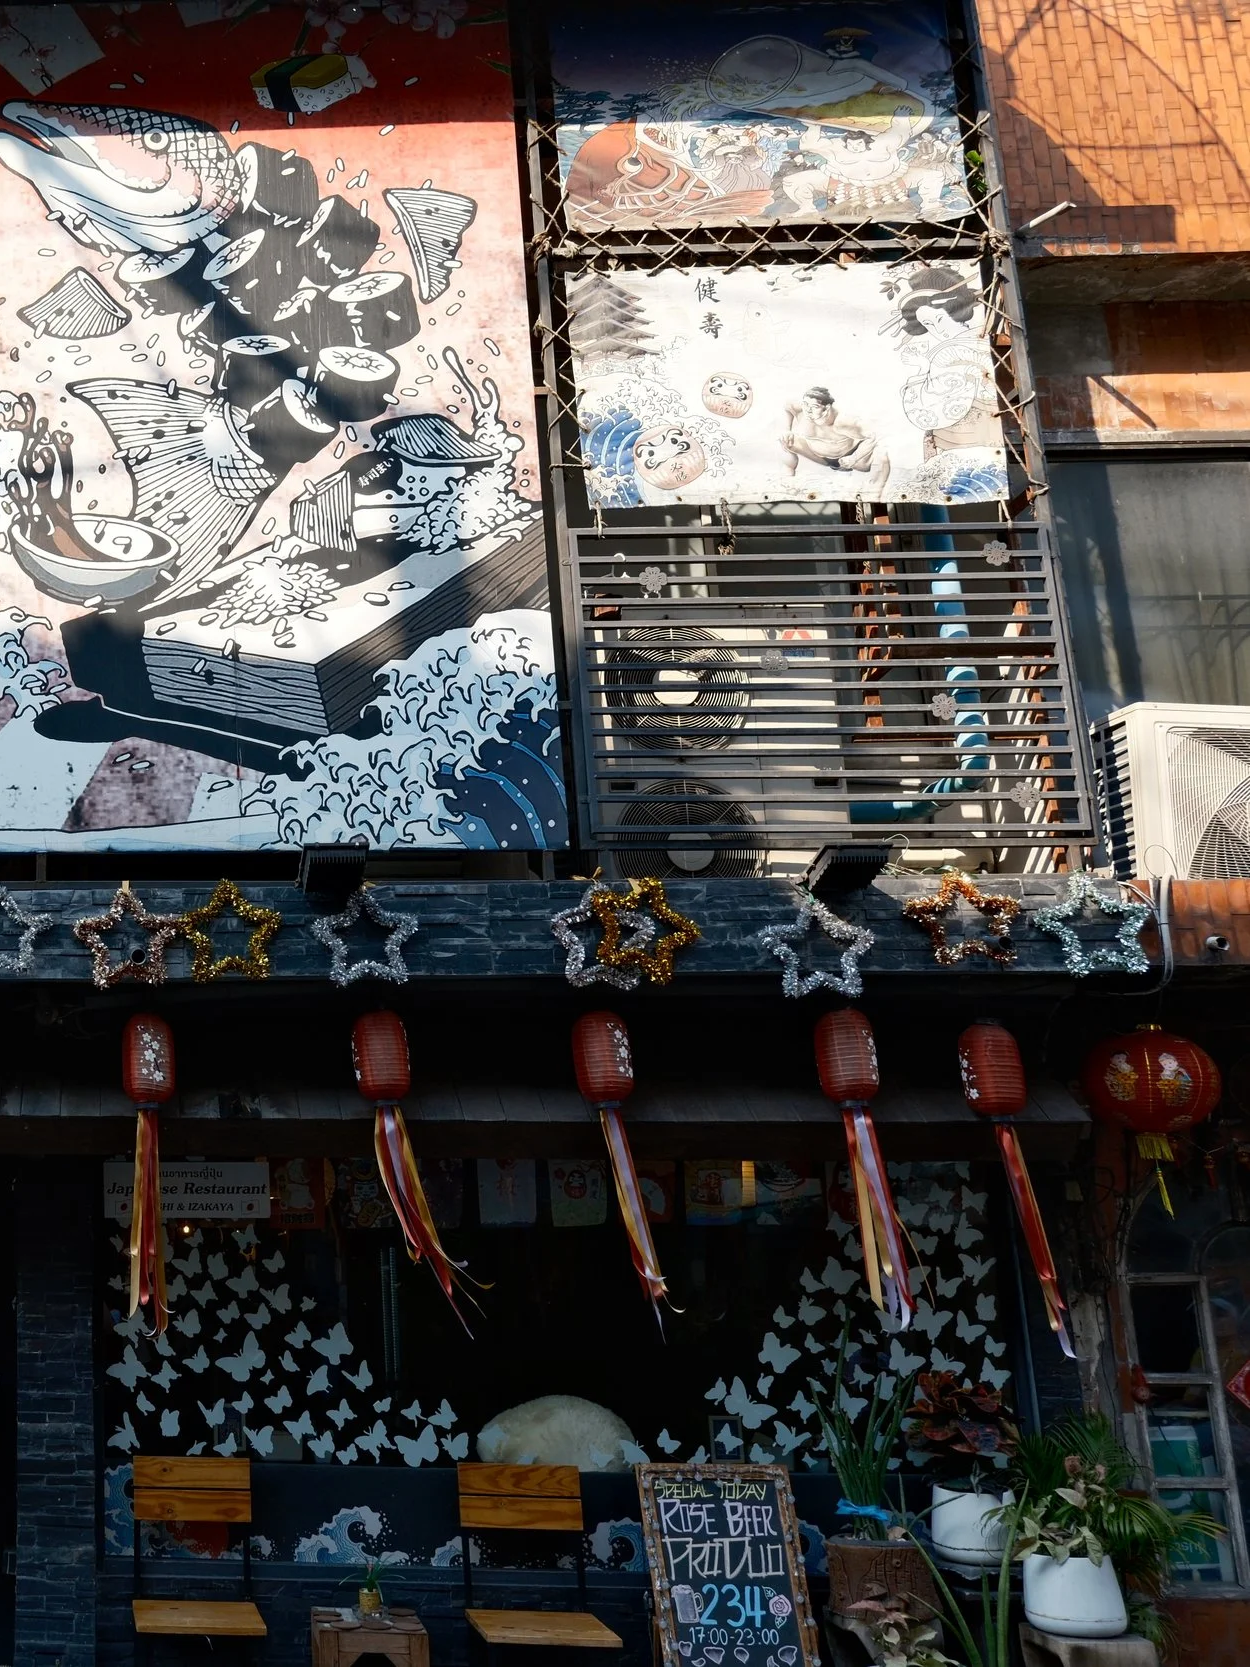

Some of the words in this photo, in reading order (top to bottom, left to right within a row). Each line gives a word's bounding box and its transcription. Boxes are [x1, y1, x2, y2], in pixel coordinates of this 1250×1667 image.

[107, 1182, 178, 1196] Japse
[183, 1183, 267, 1195] Restaurant
[176, 1203, 185, 1211] &
[188, 1203, 234, 1211] IZAKAYA
[654, 1482, 714, 1500] SPECIAL
[718, 1482, 767, 1500] TODAY
[658, 1499, 718, 1536] ROSE
[723, 1499, 778, 1537] BEER
[699, 1583, 767, 1628] 234
[688, 1626, 780, 1646] 17:00-23:00
